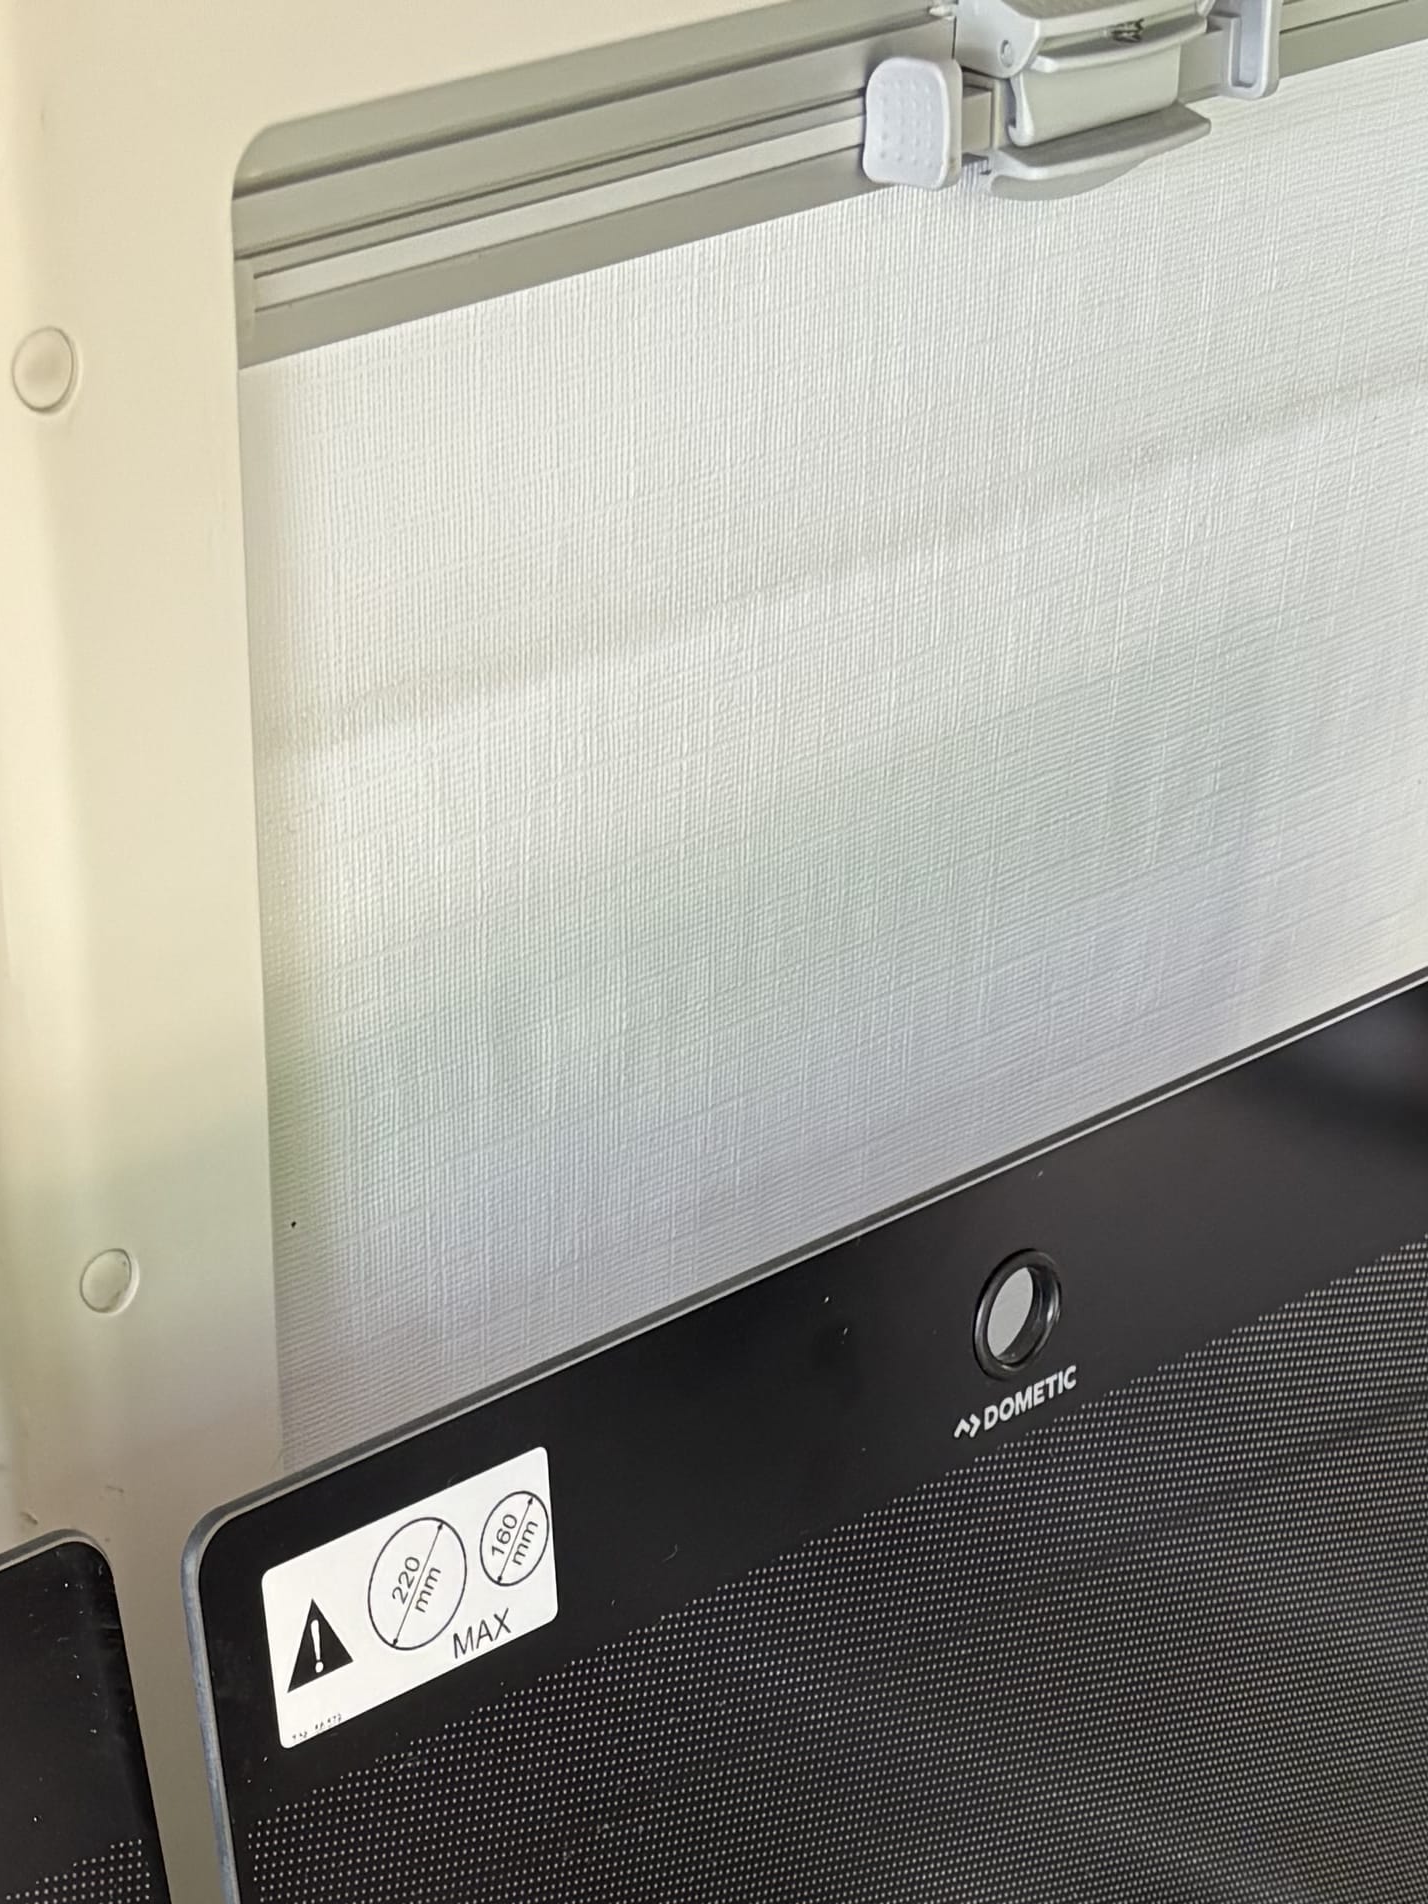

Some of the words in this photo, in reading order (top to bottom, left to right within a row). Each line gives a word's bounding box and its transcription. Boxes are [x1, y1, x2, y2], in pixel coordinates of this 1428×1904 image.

[984, 1365, 1077, 1431] DOMETIC
[491, 1513, 518, 1557] 160
[512, 1519, 539, 1566] mm
[391, 1556, 421, 1604] 220
[414, 1566, 442, 1613] mm
[452, 1608, 511, 1659] MAX
